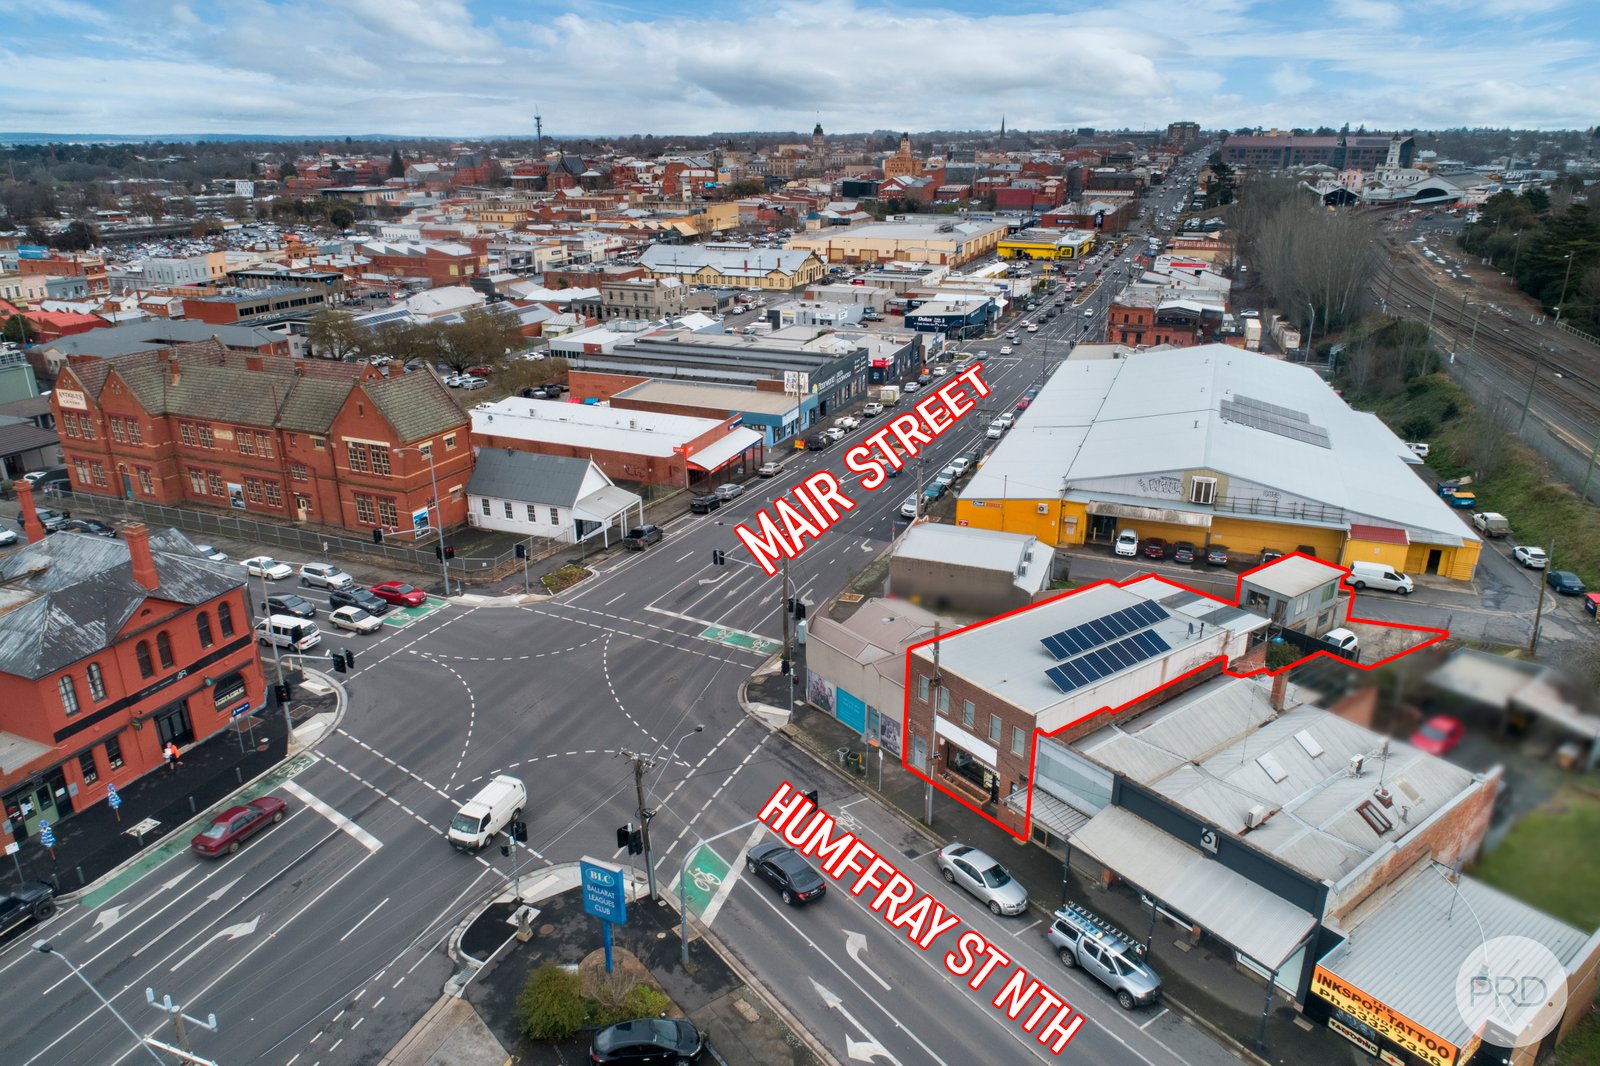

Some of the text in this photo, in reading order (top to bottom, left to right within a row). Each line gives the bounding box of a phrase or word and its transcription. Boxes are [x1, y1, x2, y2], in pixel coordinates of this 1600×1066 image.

[1201, 830, 1218, 849] 61
[590, 870, 611, 884] BLC
[586, 884, 615, 899] BALLARAT
[588, 893, 615, 908] LEAGUES
[594, 904, 611, 915] CLUB
[1373, 1000, 1396, 1014] THE
[1316, 973, 1383, 1018] INKSPOT
[1388, 1013, 1450, 1059] TATTOO
[1358, 1005, 1402, 1034] STUDIO
[1397, 1035, 1441, 1066] 7336
